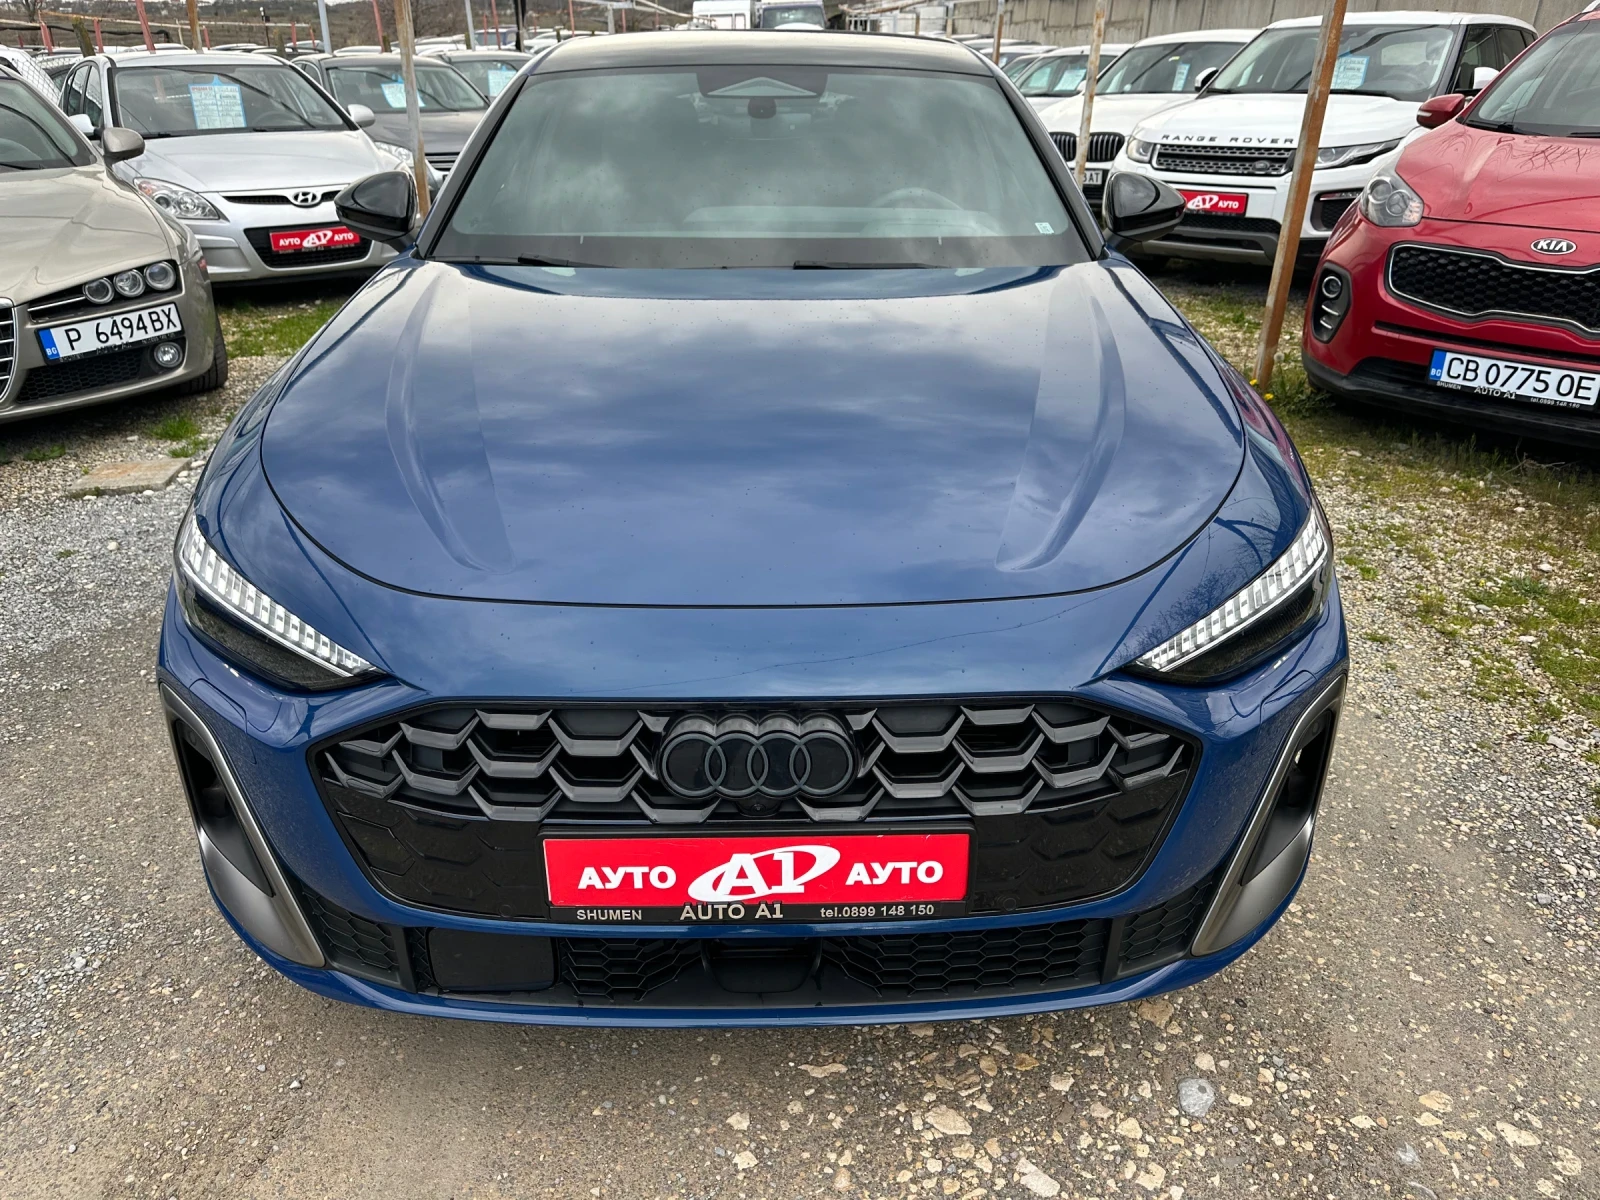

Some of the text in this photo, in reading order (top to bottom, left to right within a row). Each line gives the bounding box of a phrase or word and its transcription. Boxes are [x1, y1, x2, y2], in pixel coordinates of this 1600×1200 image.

[1161, 134, 1294, 145] RANGE ROVER
[1537, 240, 1567, 252] KIA
[64, 327, 82, 351] P
[45, 348, 58, 356] BG
[1430, 367, 1442, 377] BG
[1446, 356, 1480, 382] CB
[1485, 363, 1552, 393] 0775
[1436, 380, 1461, 390] SHUMEN
[1474, 385, 1517, 400] AUTO A1
[577, 865, 677, 890] АУТО
[845, 860, 944, 885] АУТО
[576, 909, 642, 921] SHUMEN
[679, 901, 784, 921] AUTO A1
[820, 904, 935, 918] tel.0899 148 150
